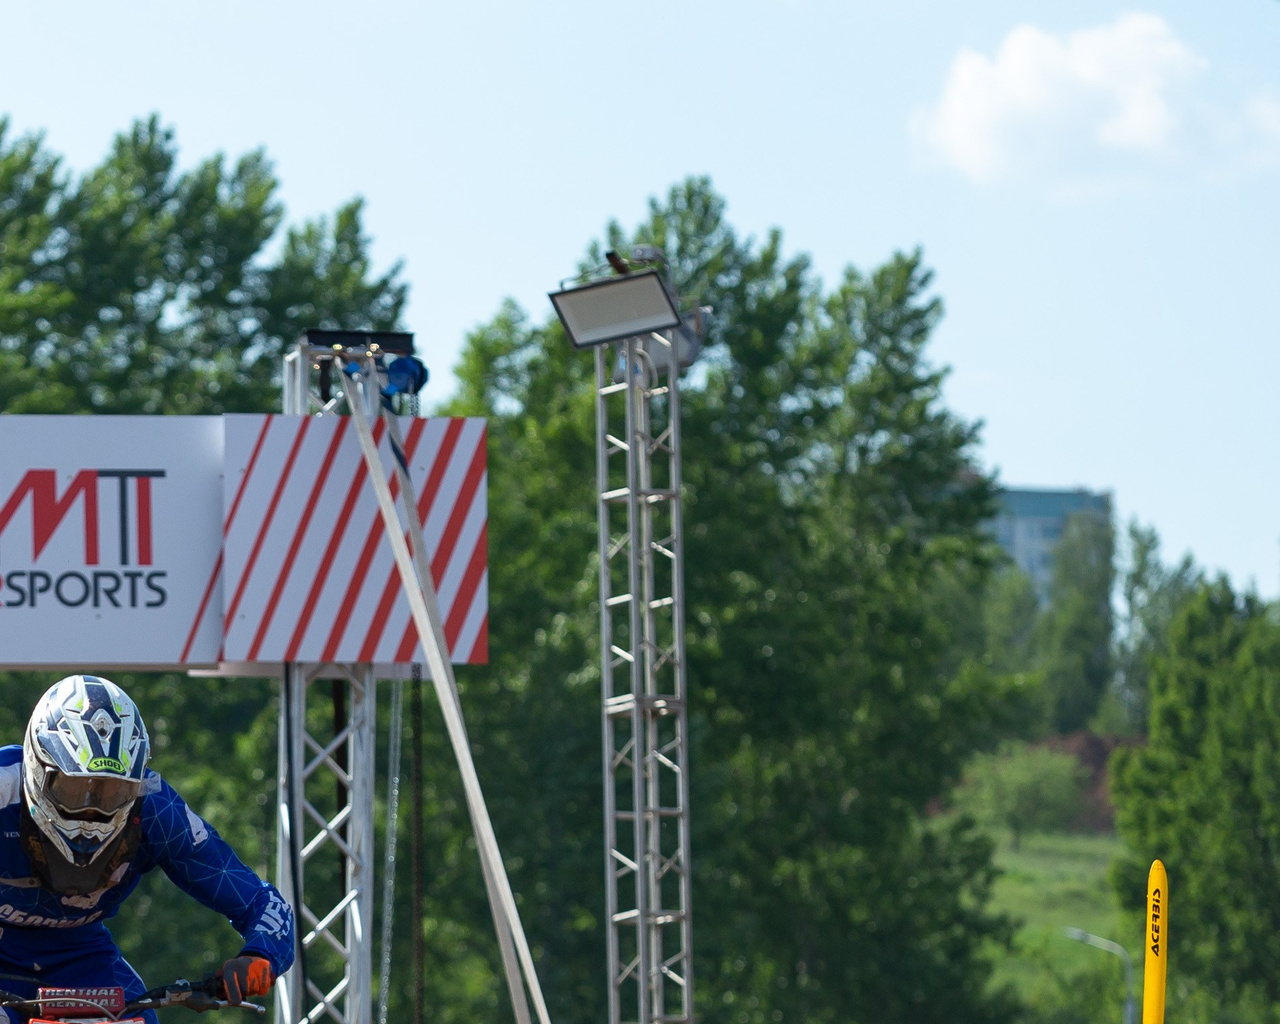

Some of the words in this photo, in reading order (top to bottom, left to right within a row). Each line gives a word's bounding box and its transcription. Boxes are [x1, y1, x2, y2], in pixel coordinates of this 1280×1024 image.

[93, 759, 121, 771] SHOEI
[1151, 888, 1160, 957] ACERBIS
[45, 988, 119, 996] RENTHAL
